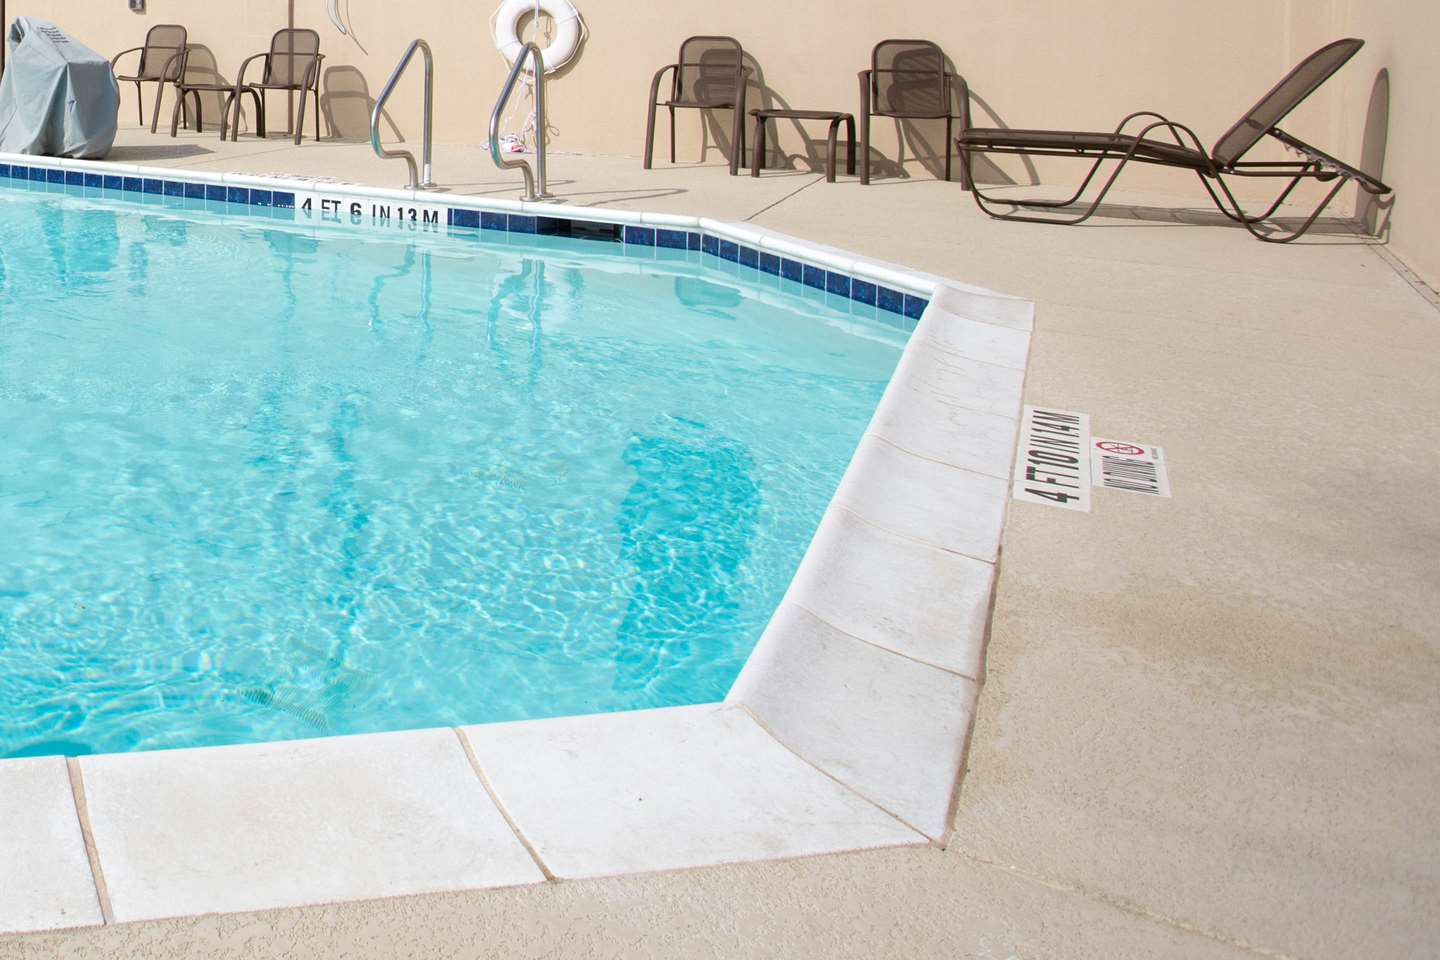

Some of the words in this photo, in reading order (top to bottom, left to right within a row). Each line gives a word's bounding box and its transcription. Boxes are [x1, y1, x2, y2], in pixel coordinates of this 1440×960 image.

[302, 198, 312, 210] 4
[350, 202, 361, 216] 6
[372, 204, 390, 219] IN
[1030, 434, 1080, 454] IN
[1027, 450, 1079, 470] 10
[1102, 455, 1158, 483] DIVING
[1026, 465, 1080, 488] FT
[1103, 478, 1161, 495] NO
[1024, 488, 1080, 503] 4
